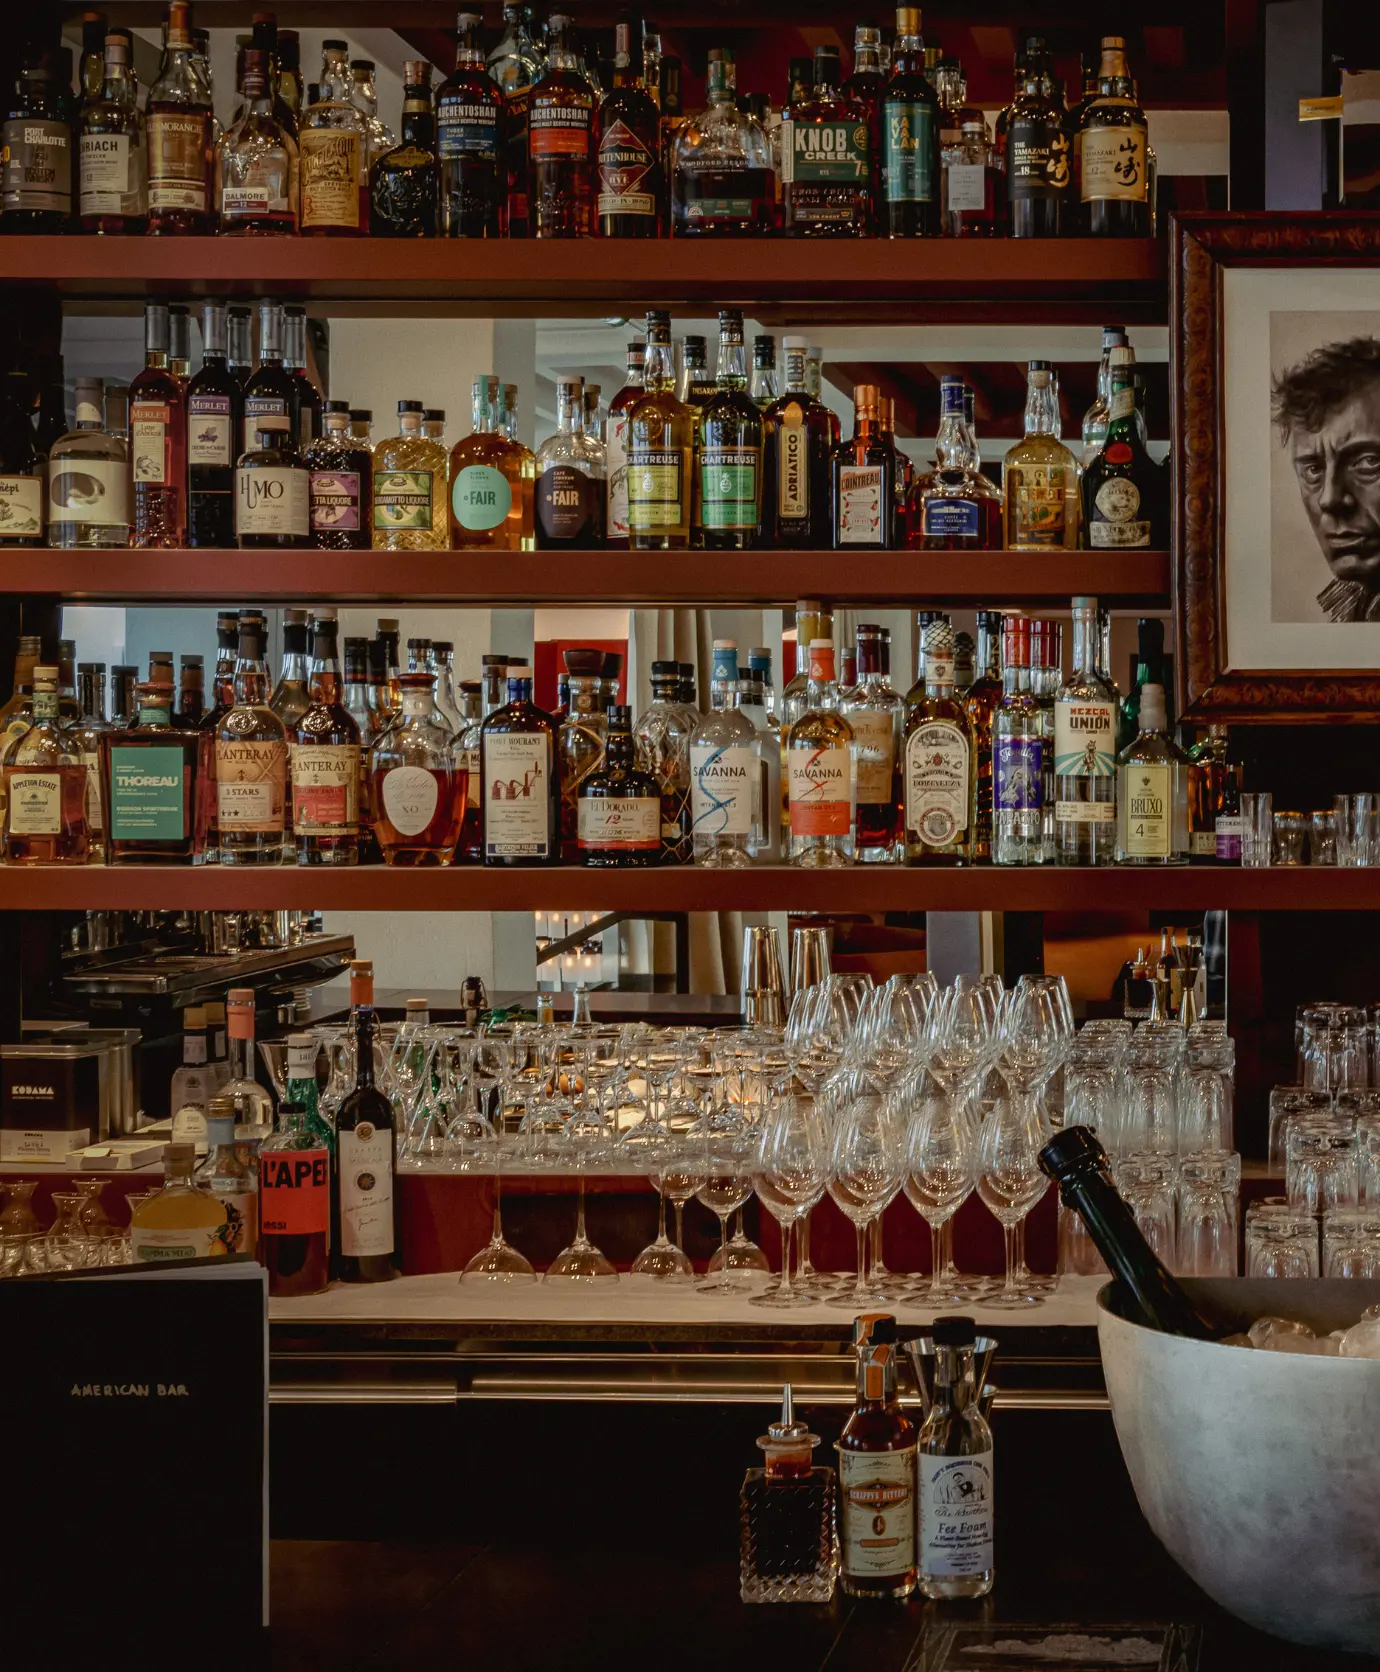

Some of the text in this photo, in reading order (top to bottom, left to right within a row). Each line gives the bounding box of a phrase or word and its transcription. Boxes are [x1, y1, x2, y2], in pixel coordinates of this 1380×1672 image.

[438, 105, 497, 120] AUCHENTOSHAN
[530, 107, 589, 121] AUCHENTOSHAN
[25, 127, 45, 138] PORT
[25, 135, 68, 147] CHARLOTTE
[795, 127, 848, 152] KNOB
[1015, 141, 1026, 150] THE
[804, 150, 858, 161] CREEK
[1015, 149, 1050, 157] YAMAZAKI
[679, 159, 722, 167] WOODFORD
[1020, 166, 1031, 176] 18
[609, 175, 631, 186] RYE
[225, 193, 266, 202] DALMORE
[191, 401, 228, 411] MERLET
[246, 402, 281, 412] MERLET
[132, 411, 167, 423] MERLET
[700, 454, 756, 465] CHARTREUSE
[788, 433, 799, 502] ADRIATICO
[841, 472, 881, 491] COINTREAU
[469, 491, 497, 507] FAIR
[552, 490, 580, 507] FAIR
[1069, 706, 1110, 716] MEZCAL
[1069, 715, 1110, 730] UNIÓN
[692, 766, 746, 778] SAVANNA
[793, 768, 843, 780] SAVANNA
[12, 779, 58, 792] APPLETON ESTATE
[116, 776, 178, 788] THOREAU
[232, 788, 259, 797] STARS
[401, 805, 419, 814] XO
[602, 800, 640, 814] DORADO
[1130, 797, 1162, 815] BRUXO
[604, 813, 621, 826] 12
[1134, 823, 1145, 838] 4
[12, 1085, 54, 1097] KODAMA
[71, 1383, 190, 1397] AMERICAN BAR
[849, 1488, 880, 1500] SCRAPPY'S
[938, 1521, 987, 1534] Fee Foam
